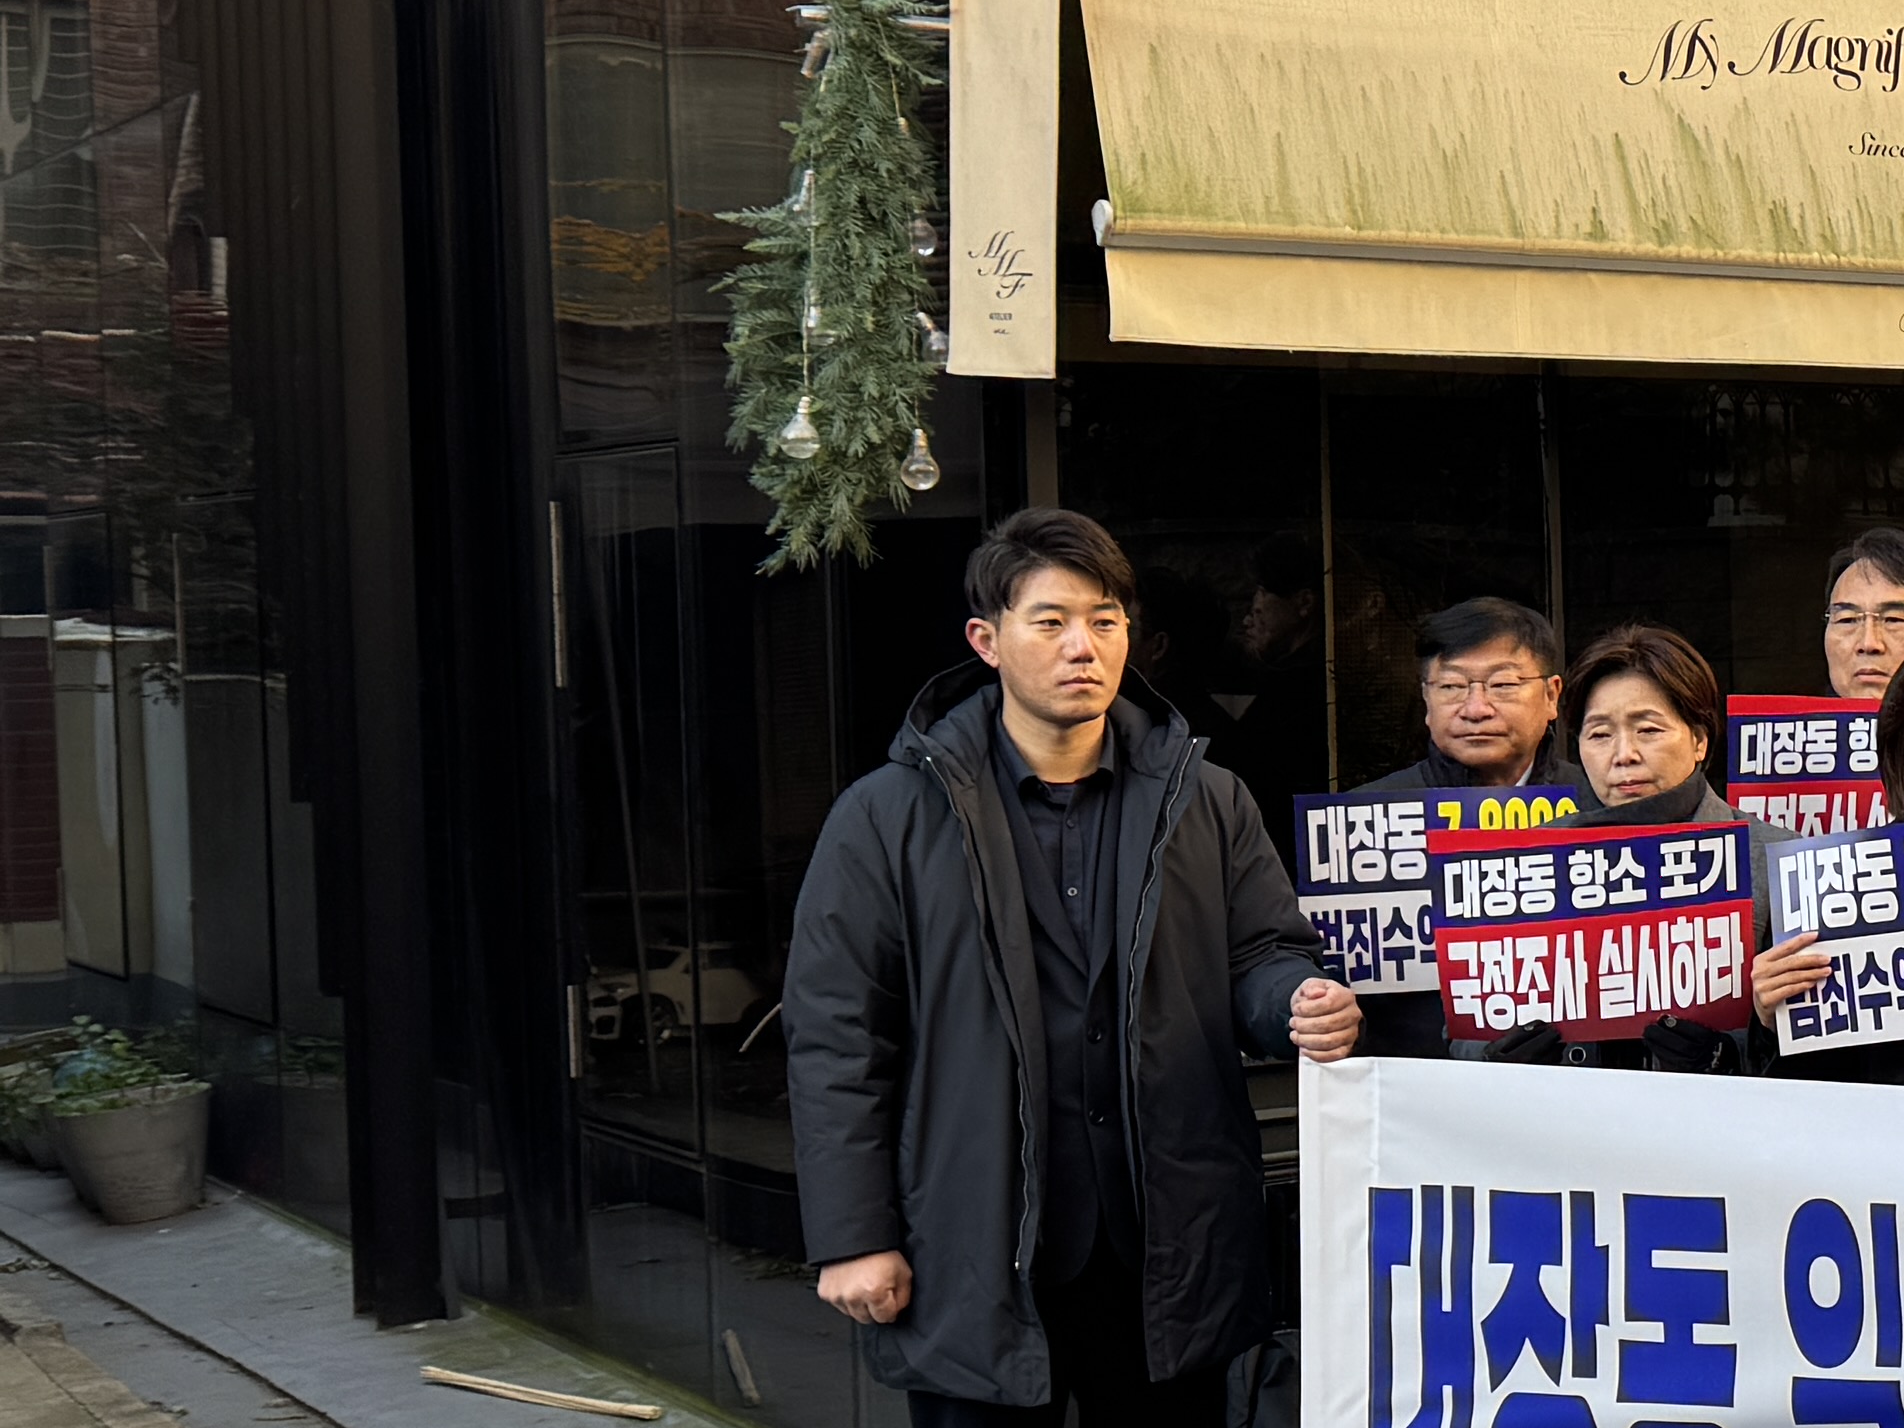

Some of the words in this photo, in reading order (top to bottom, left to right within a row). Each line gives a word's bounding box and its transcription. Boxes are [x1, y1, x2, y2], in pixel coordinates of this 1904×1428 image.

[1619, 18, 1719, 90] My
[1740, 720, 1837, 775] 대장동
[1849, 718, 1879, 772] 항
[1306, 801, 1428, 884] 대장동
[1443, 853, 1557, 919] 대장동
[1569, 846, 1647, 909] 항소
[1660, 834, 1736, 900] 포기
[1779, 838, 1899, 933] 대장동
[1448, 929, 1589, 1030] 국정조사
[1598, 912, 1744, 1019] 실시하라
